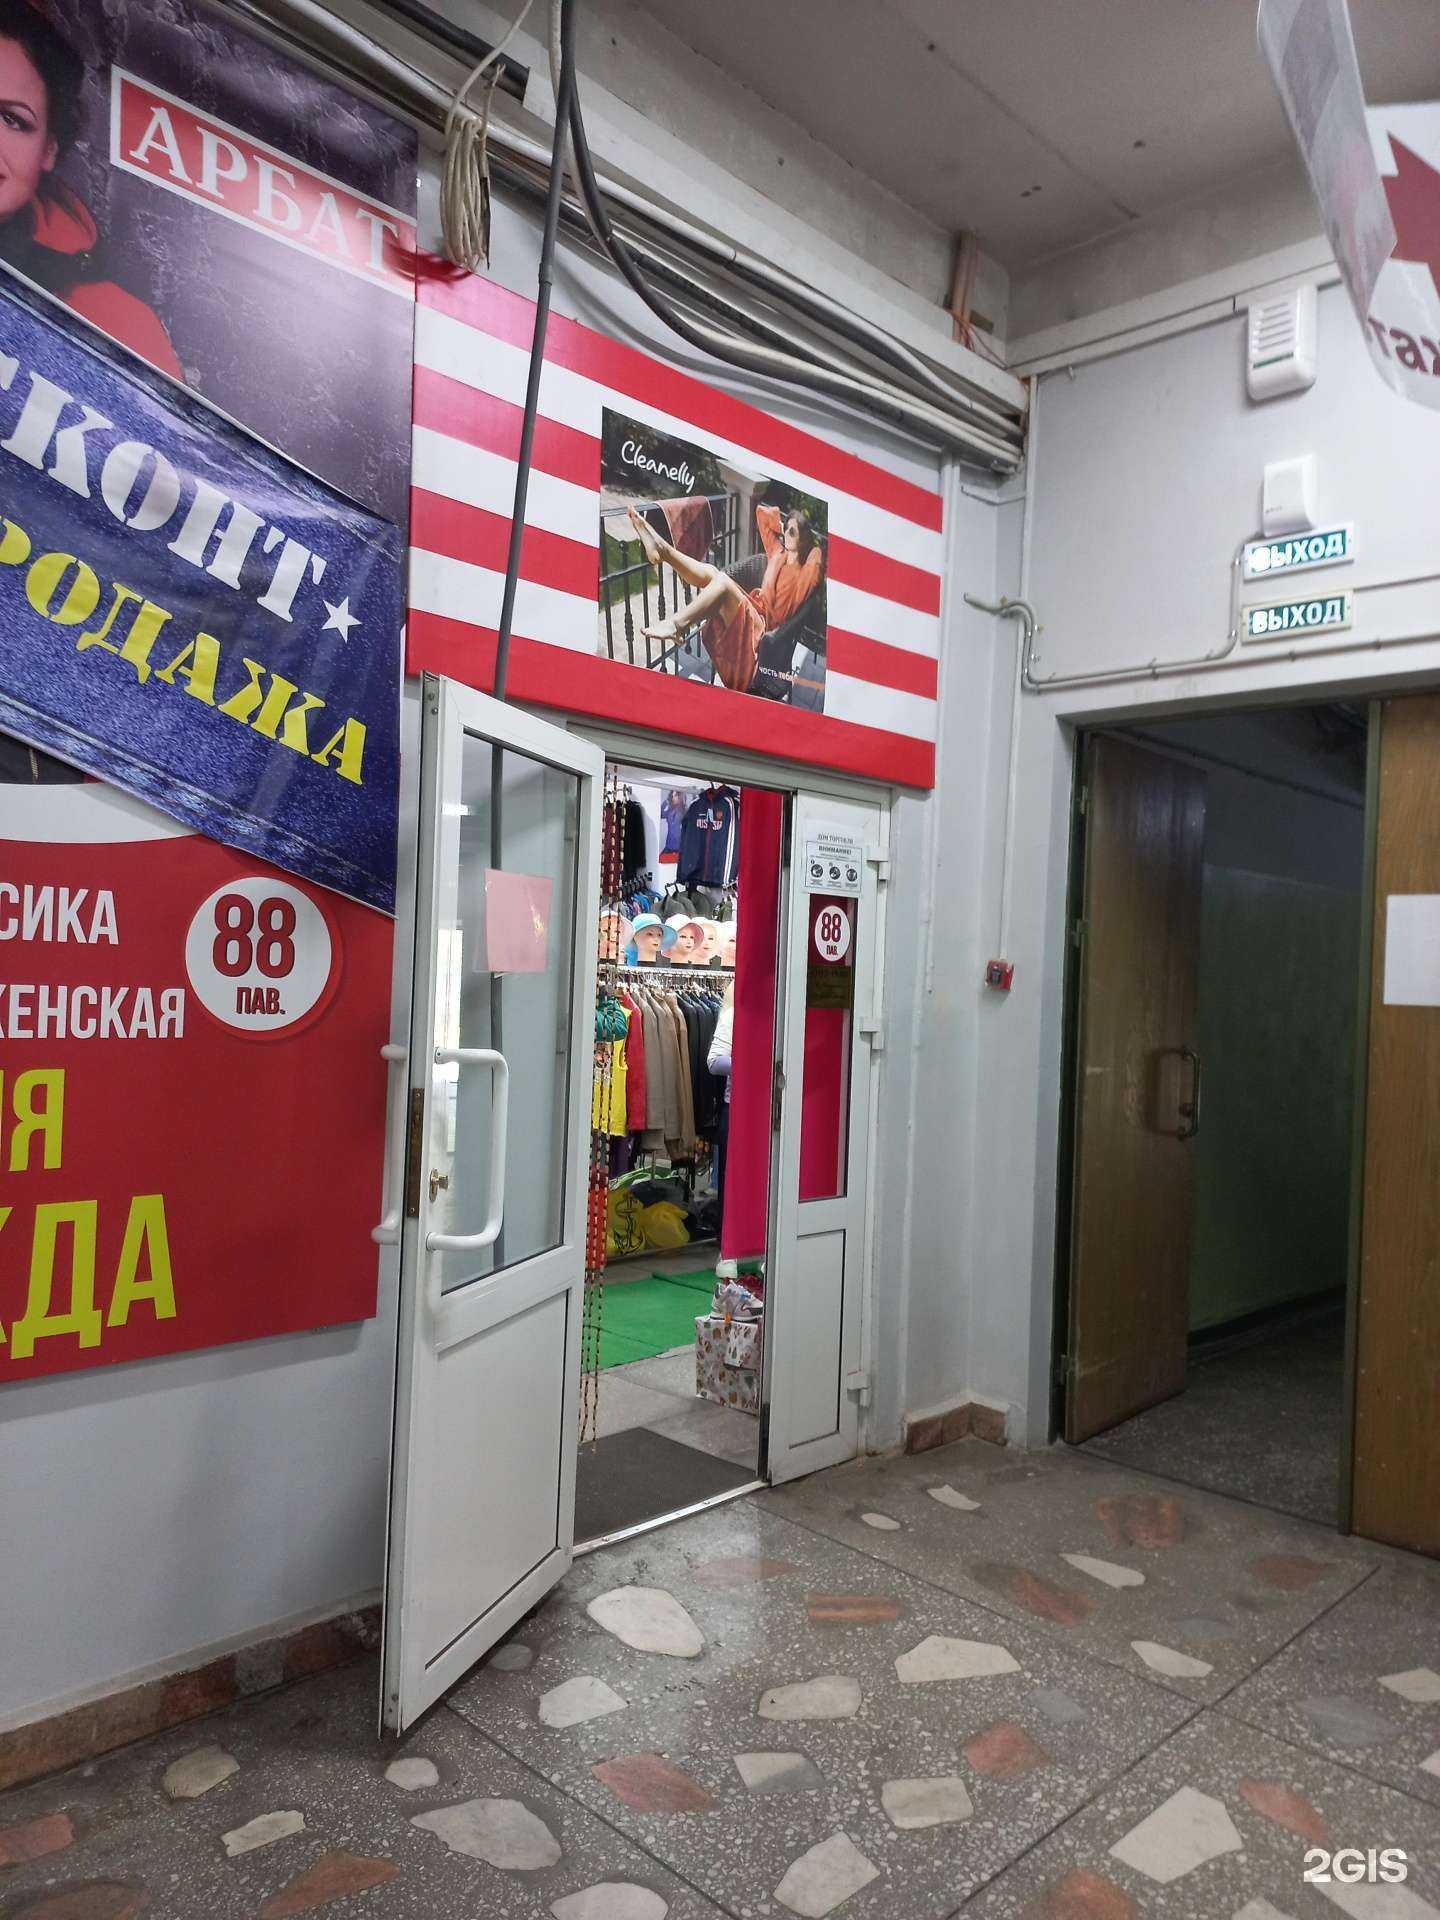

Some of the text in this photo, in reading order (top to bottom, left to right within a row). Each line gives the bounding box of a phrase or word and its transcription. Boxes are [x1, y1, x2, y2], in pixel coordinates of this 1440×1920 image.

[130, 107, 399, 274] АРБАТ
[0, 354, 327, 622] КОНТ
[621, 440, 695, 494] Cleanelly
[1252, 599, 1342, 634] ВЫХОД
[212, 893, 297, 979] 88
[821, 912, 842, 942] 88
[235, 986, 286, 1015] ПАВ.
[0, 1069, 65, 1172] Я
[0, 1194, 177, 1360] ДА
